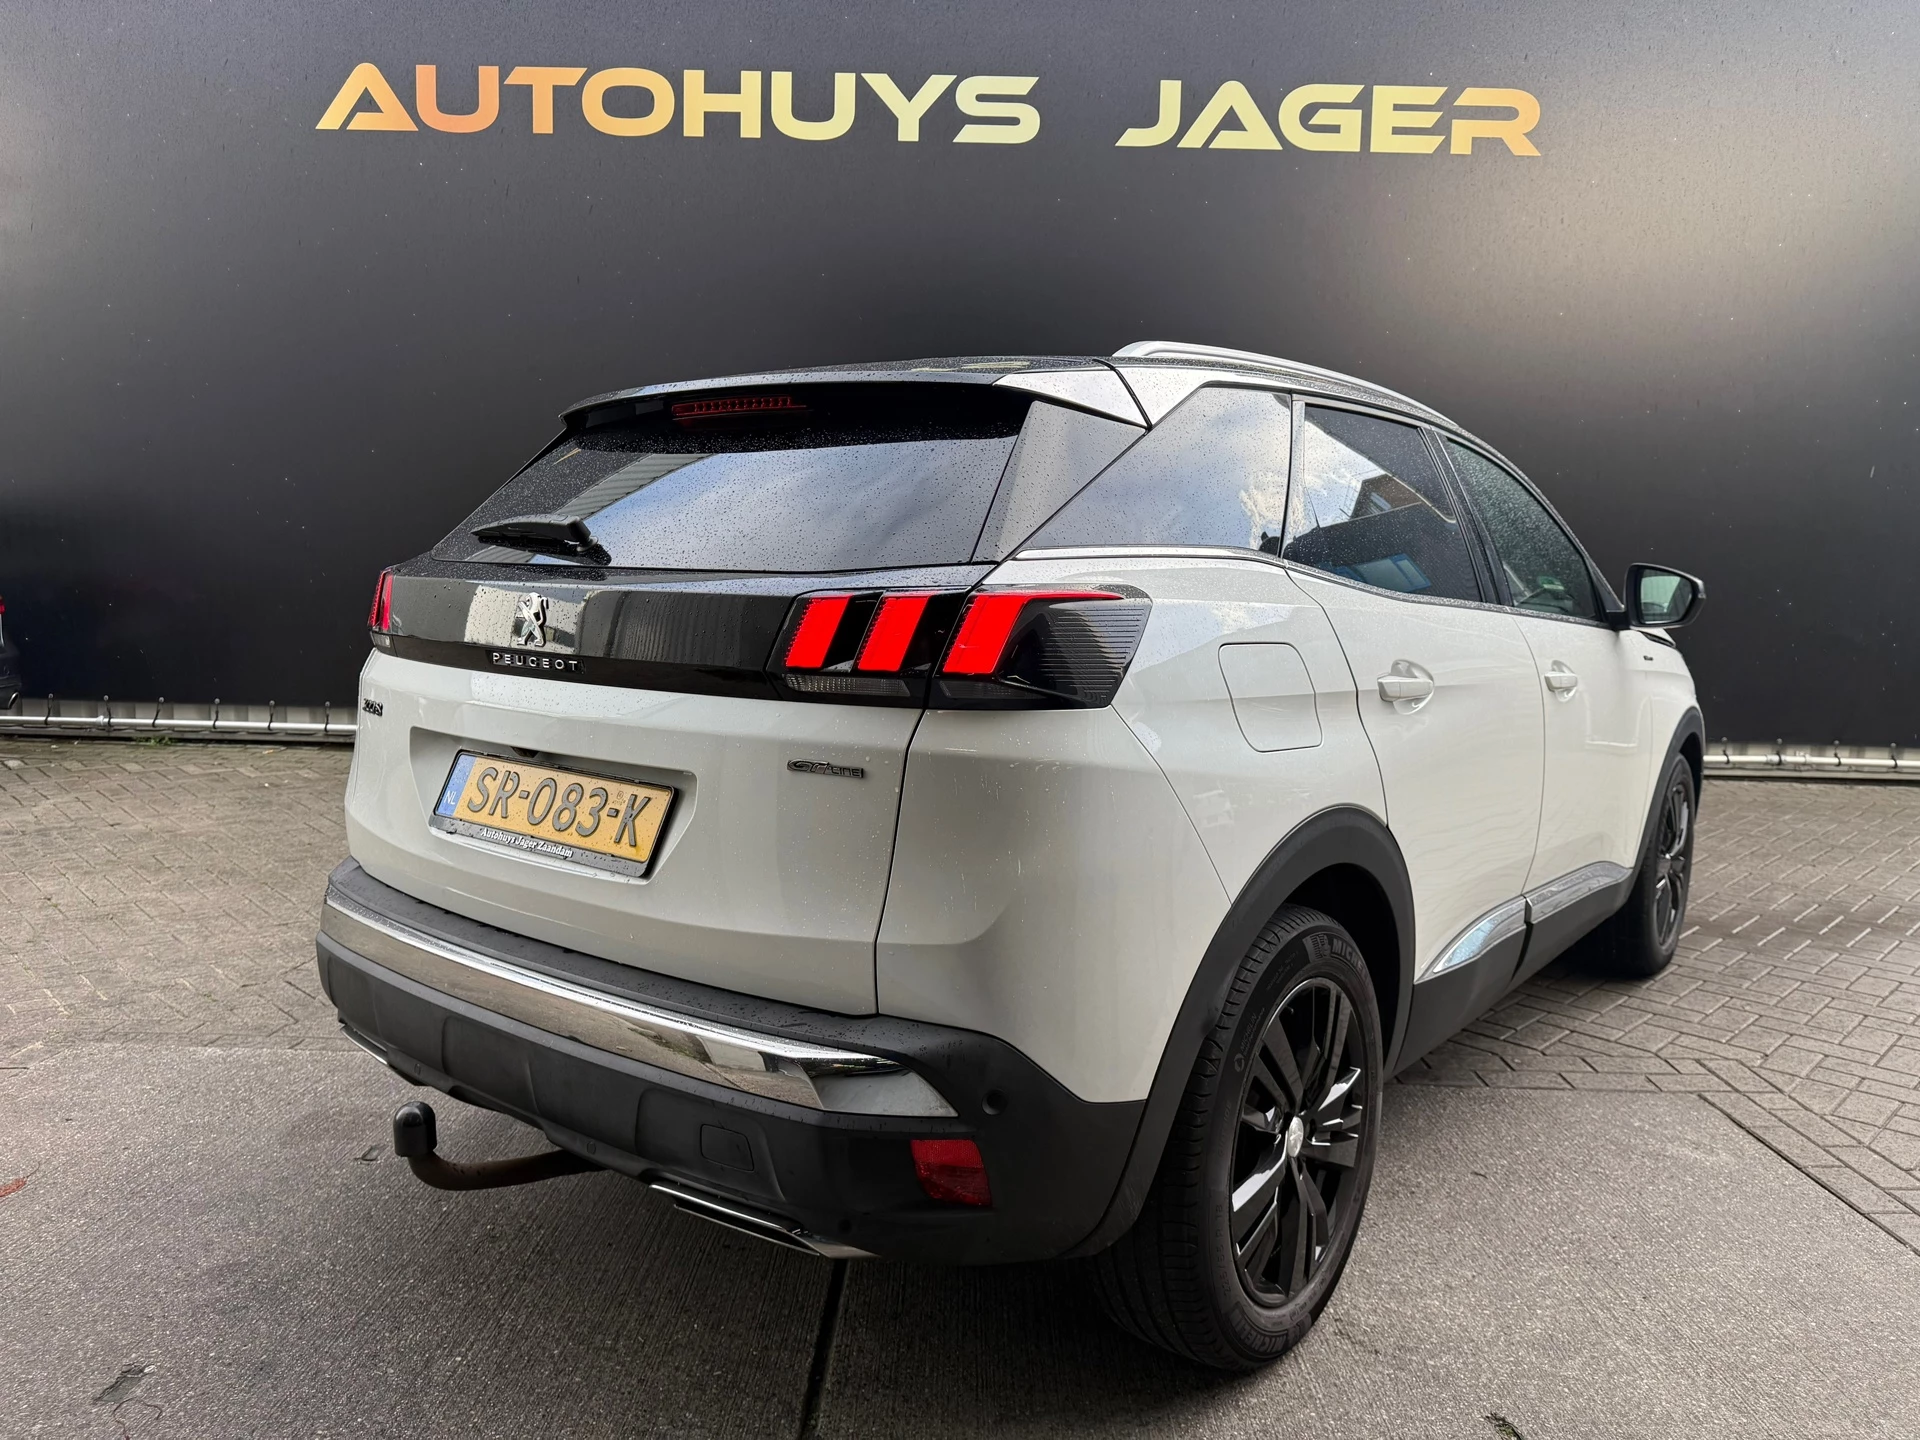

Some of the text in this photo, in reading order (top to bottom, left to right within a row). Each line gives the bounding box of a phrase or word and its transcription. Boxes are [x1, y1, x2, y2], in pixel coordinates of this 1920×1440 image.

[315, 63, 1542, 156] AUTOHUYS JAGER
[492, 652, 578, 671] PEUGEOT
[443, 790, 456, 805] NL
[467, 767, 651, 847] SR-083-K
[480, 827, 516, 844] Autohuys
[537, 841, 573, 858] Zaandam
